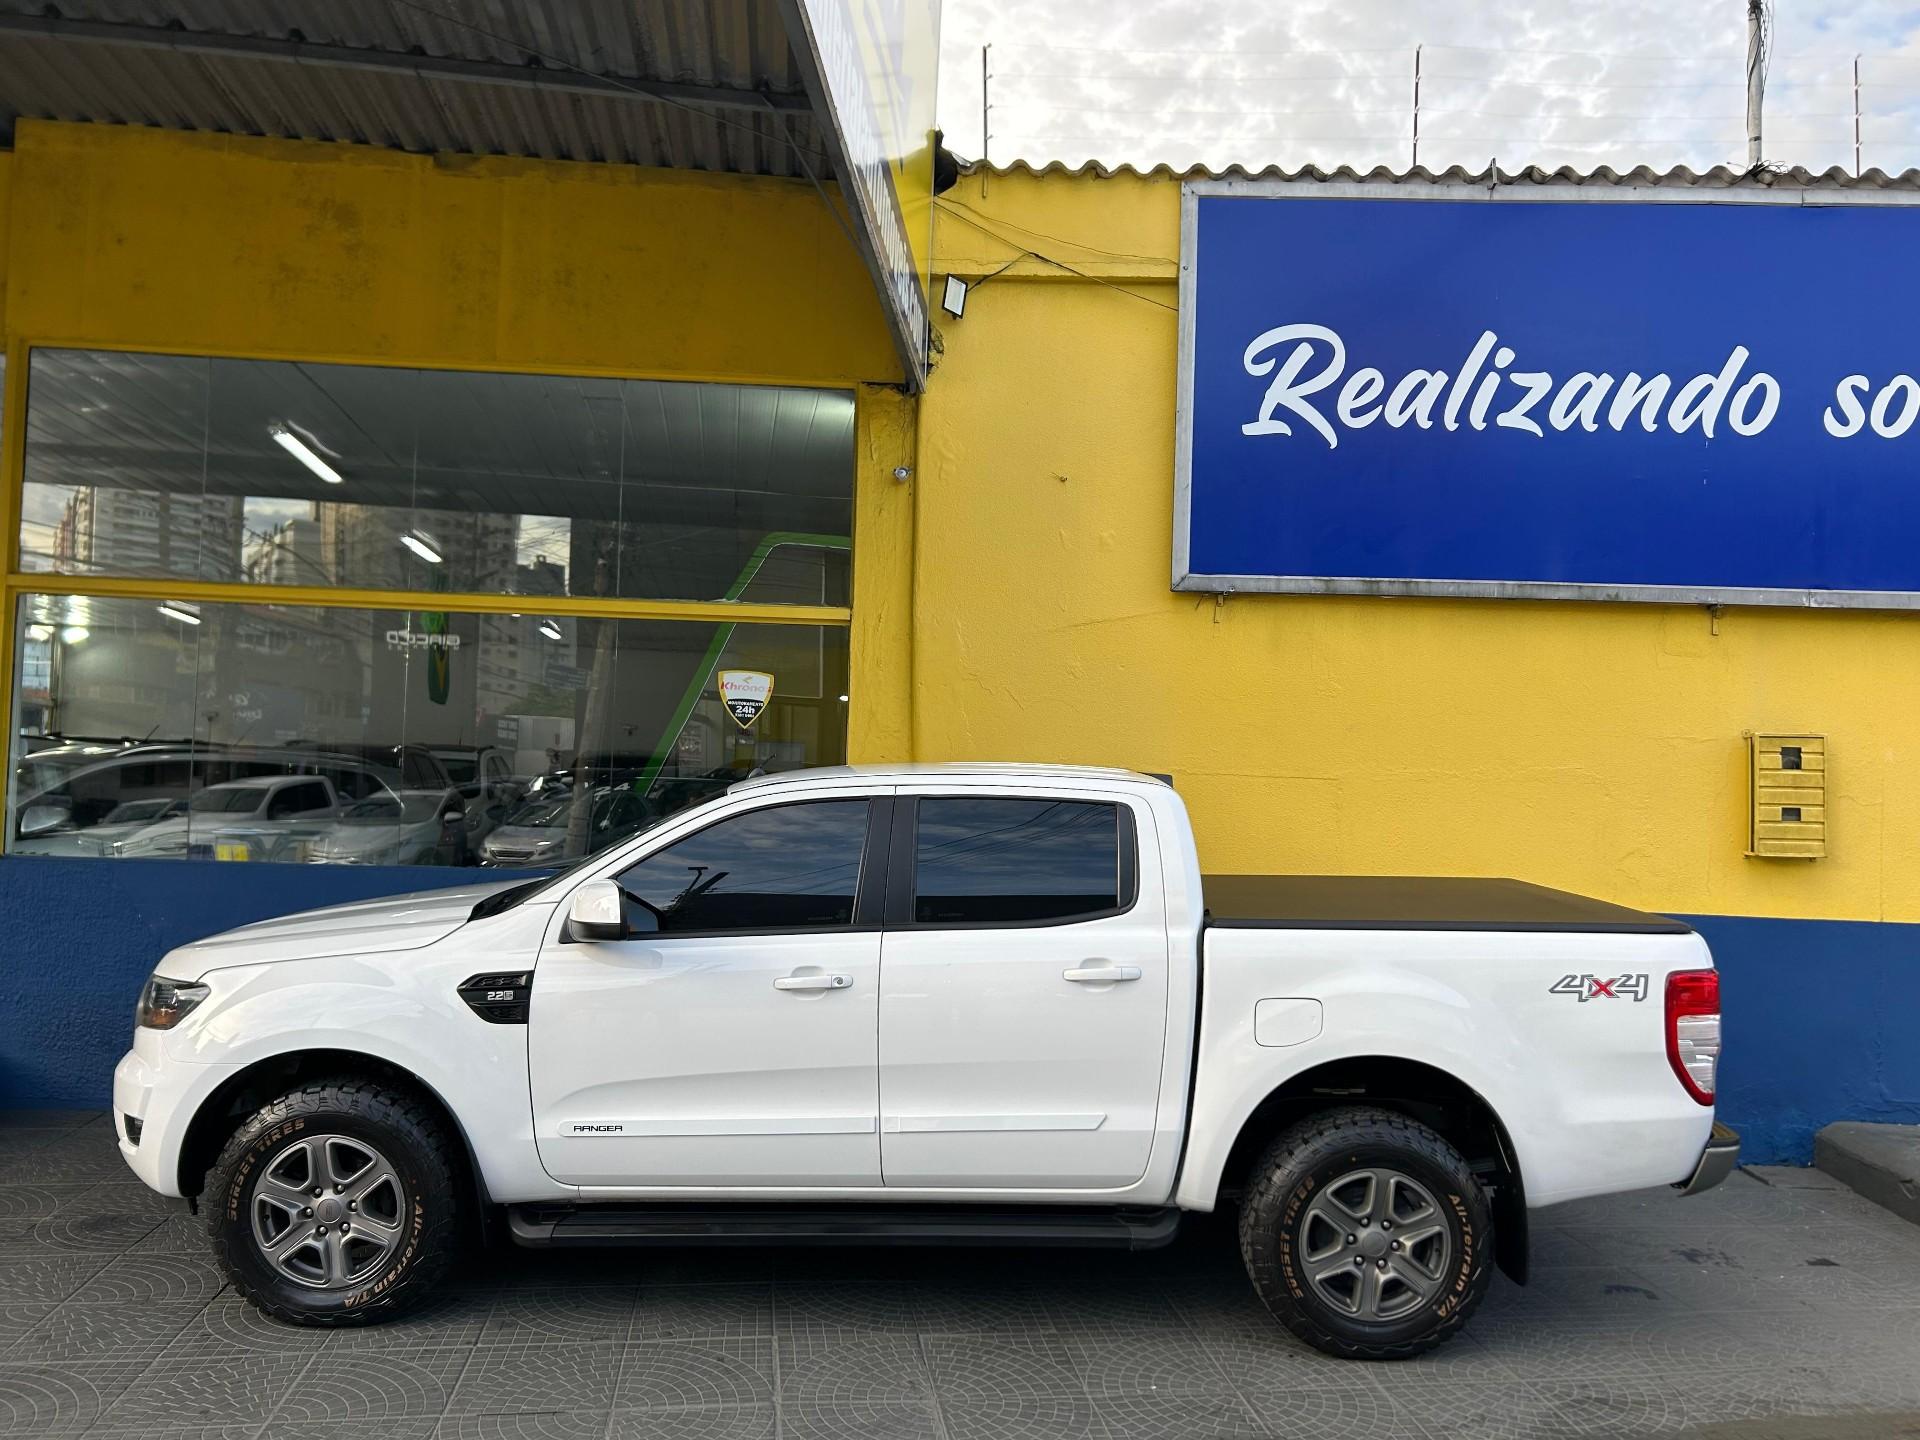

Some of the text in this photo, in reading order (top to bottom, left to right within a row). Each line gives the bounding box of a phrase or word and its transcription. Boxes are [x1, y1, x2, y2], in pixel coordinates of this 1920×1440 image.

[1242, 324, 1780, 449] Realizando
[736, 706, 755, 714] 24h
[227, 1118, 305, 1221] SUNSET TIRES
[344, 1202, 423, 1308] All-Terrain T/A
[1280, 1176, 1315, 1298] SUNSET TIRES
[1439, 1194, 1473, 1317] All-Terrain T/A
